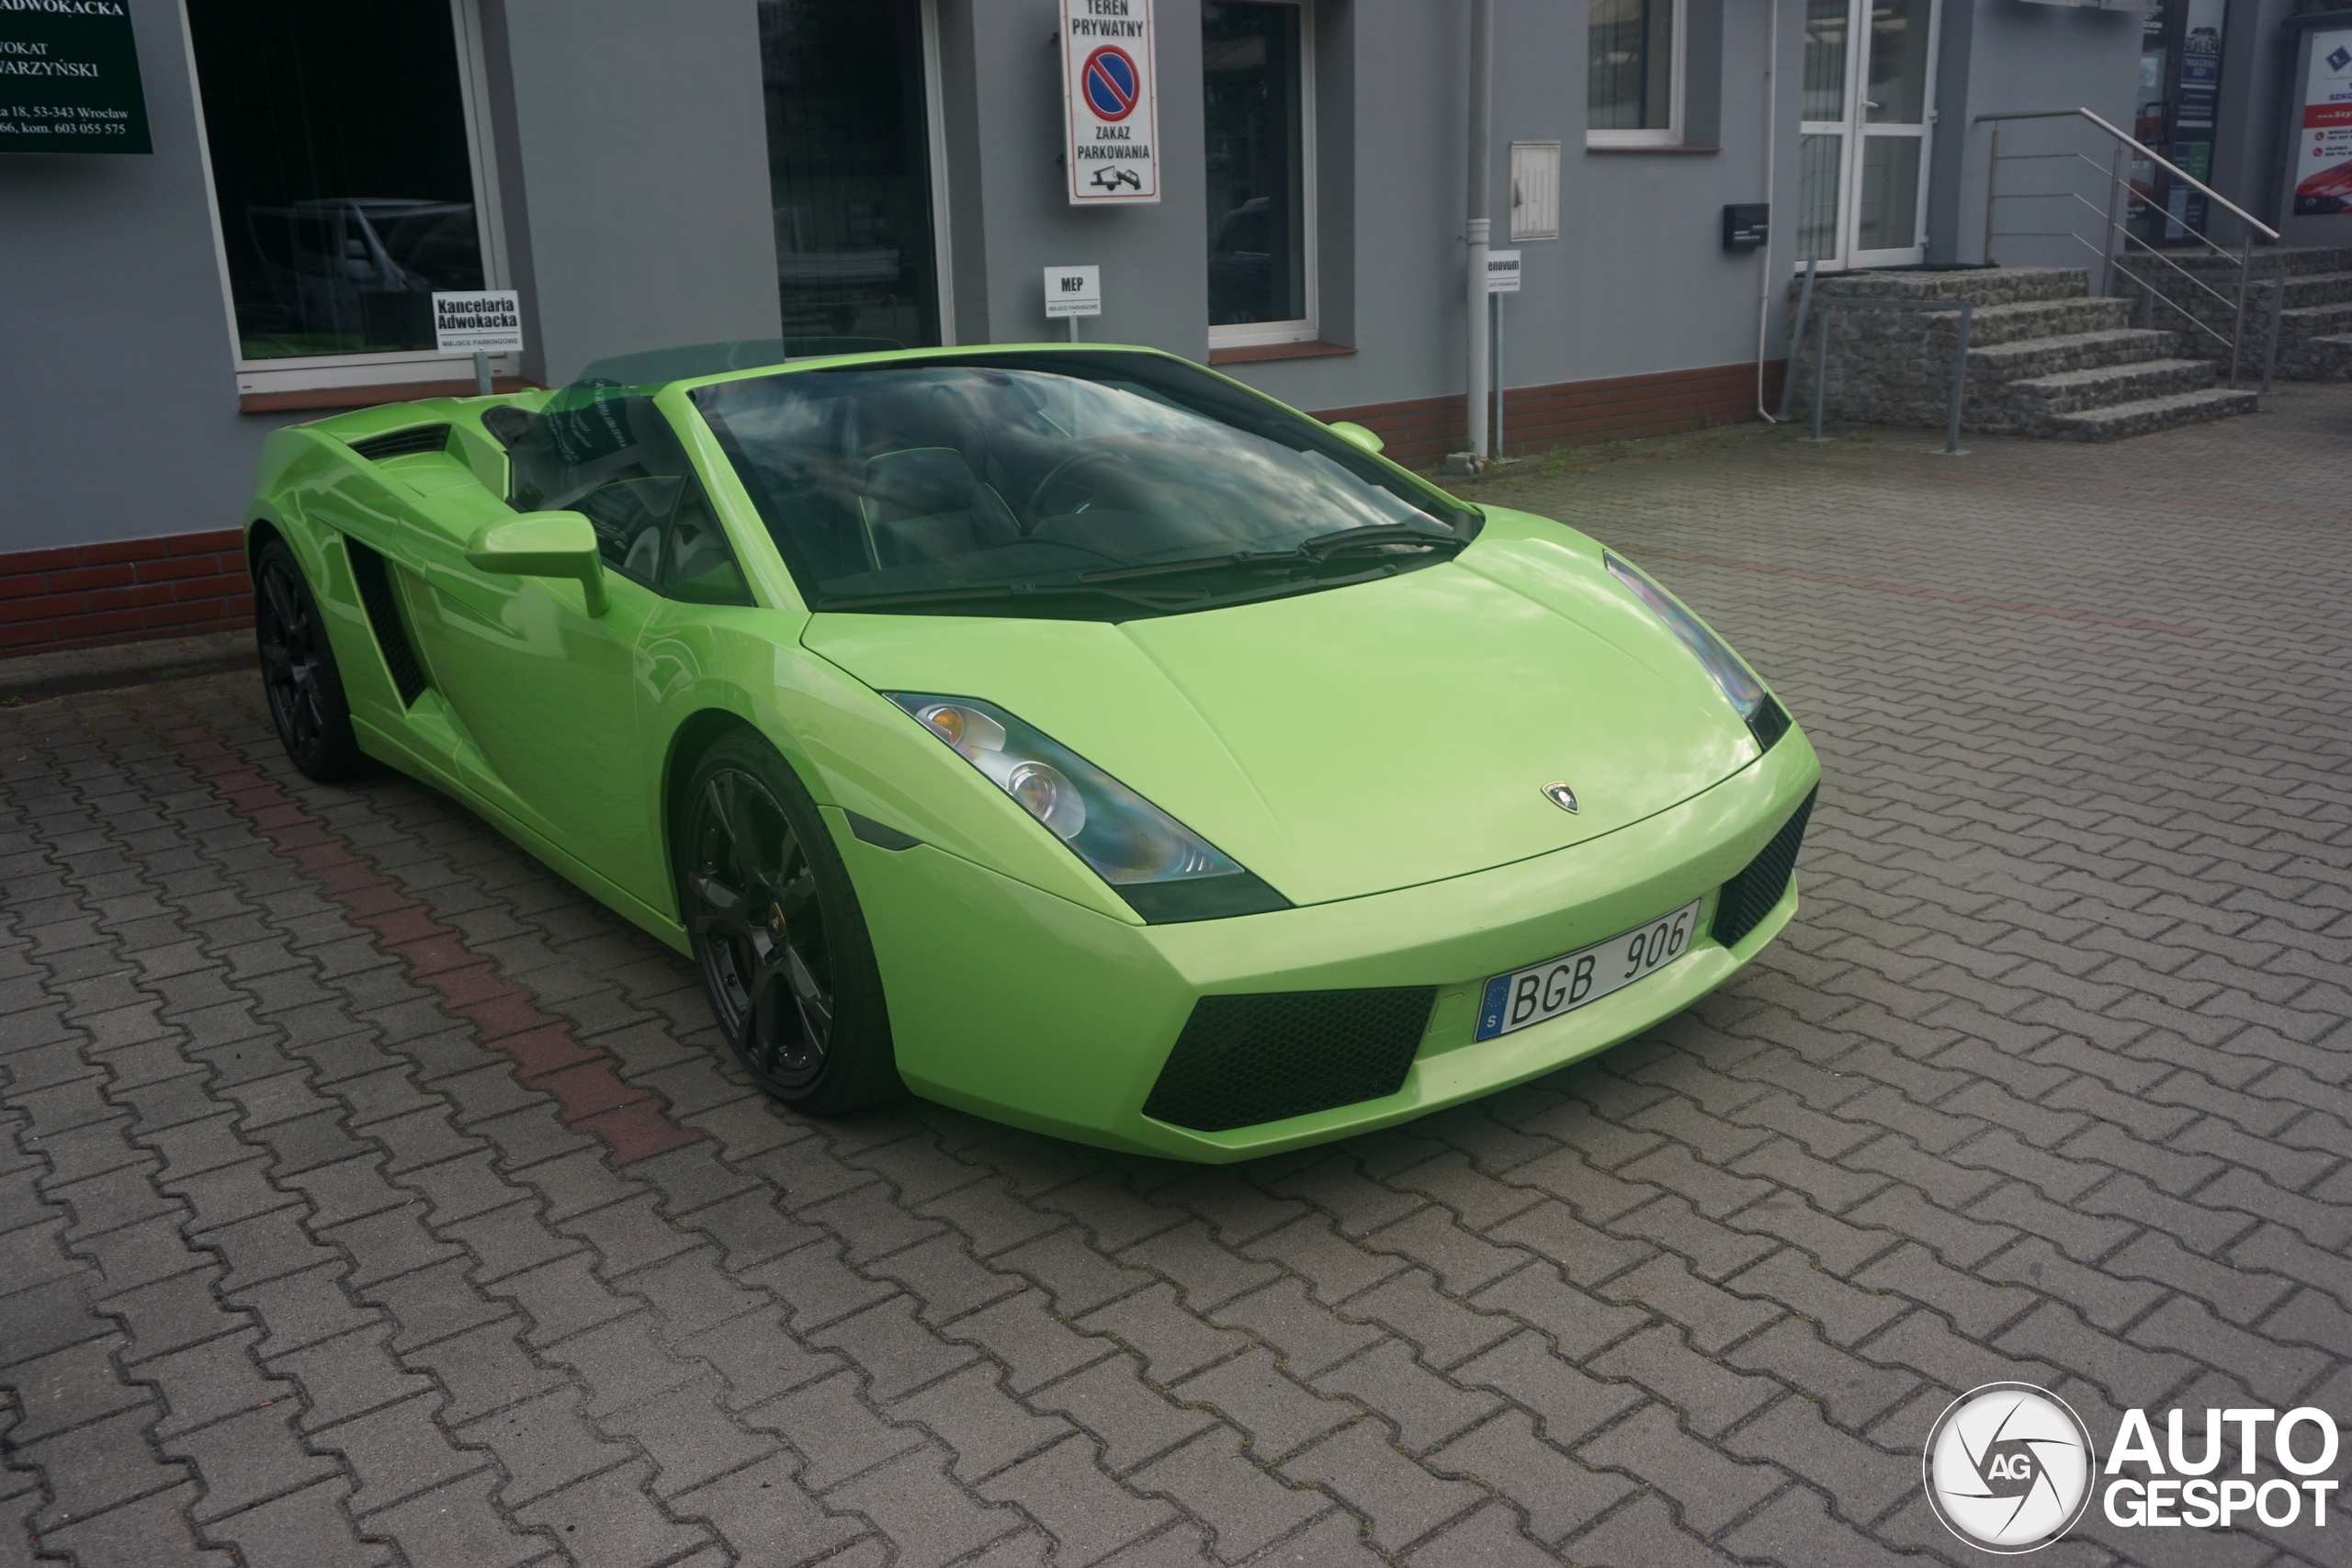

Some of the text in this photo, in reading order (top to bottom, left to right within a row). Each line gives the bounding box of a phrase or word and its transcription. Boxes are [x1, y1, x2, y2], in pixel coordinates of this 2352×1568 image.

[0, 0, 124, 15] ADWOKACKA
[1088, 0, 1129, 16] TEREN
[1072, 18, 1144, 38] PRYWATNY
[0, 41, 49, 55] OKAT
[12, 106, 31, 118] 18,
[33, 106, 74, 118] 53-343
[77, 107, 129, 118] Wrocław
[21, 122, 51, 133] kom.
[55, 123, 76, 133] 603
[79, 123, 101, 134] 055
[105, 124, 126, 135] 575
[1095, 126, 1130, 140] ZAKAZ
[1078, 145, 1150, 160] PARKOWANIA
[1061, 276, 1083, 292] MEP
[437, 298, 514, 314] Kancelaria
[438, 313, 517, 329] Adwokacka
[1511, 911, 1689, 1025] BGB 906
[1487, 1014, 1497, 1028] S
